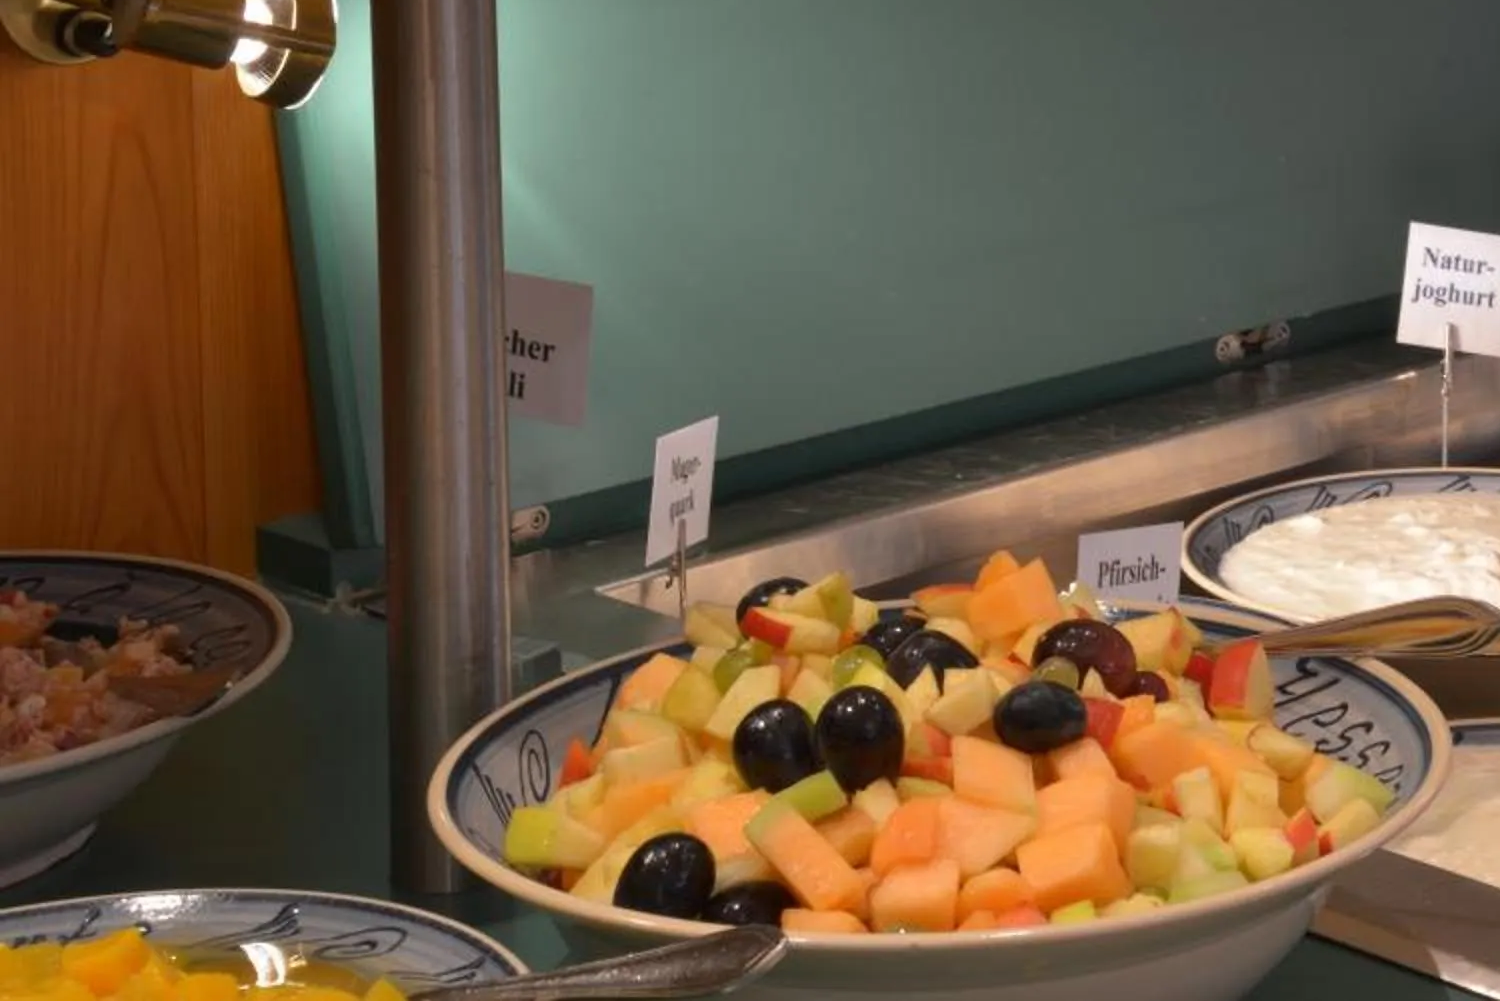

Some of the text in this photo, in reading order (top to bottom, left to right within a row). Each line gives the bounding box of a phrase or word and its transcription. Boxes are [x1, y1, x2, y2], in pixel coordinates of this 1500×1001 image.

[1421, 246, 1496, 275] Natur-
[1410, 278, 1497, 309] joghurt
[503, 328, 557, 363] her
[1097, 553, 1167, 590] Pfirsich-
